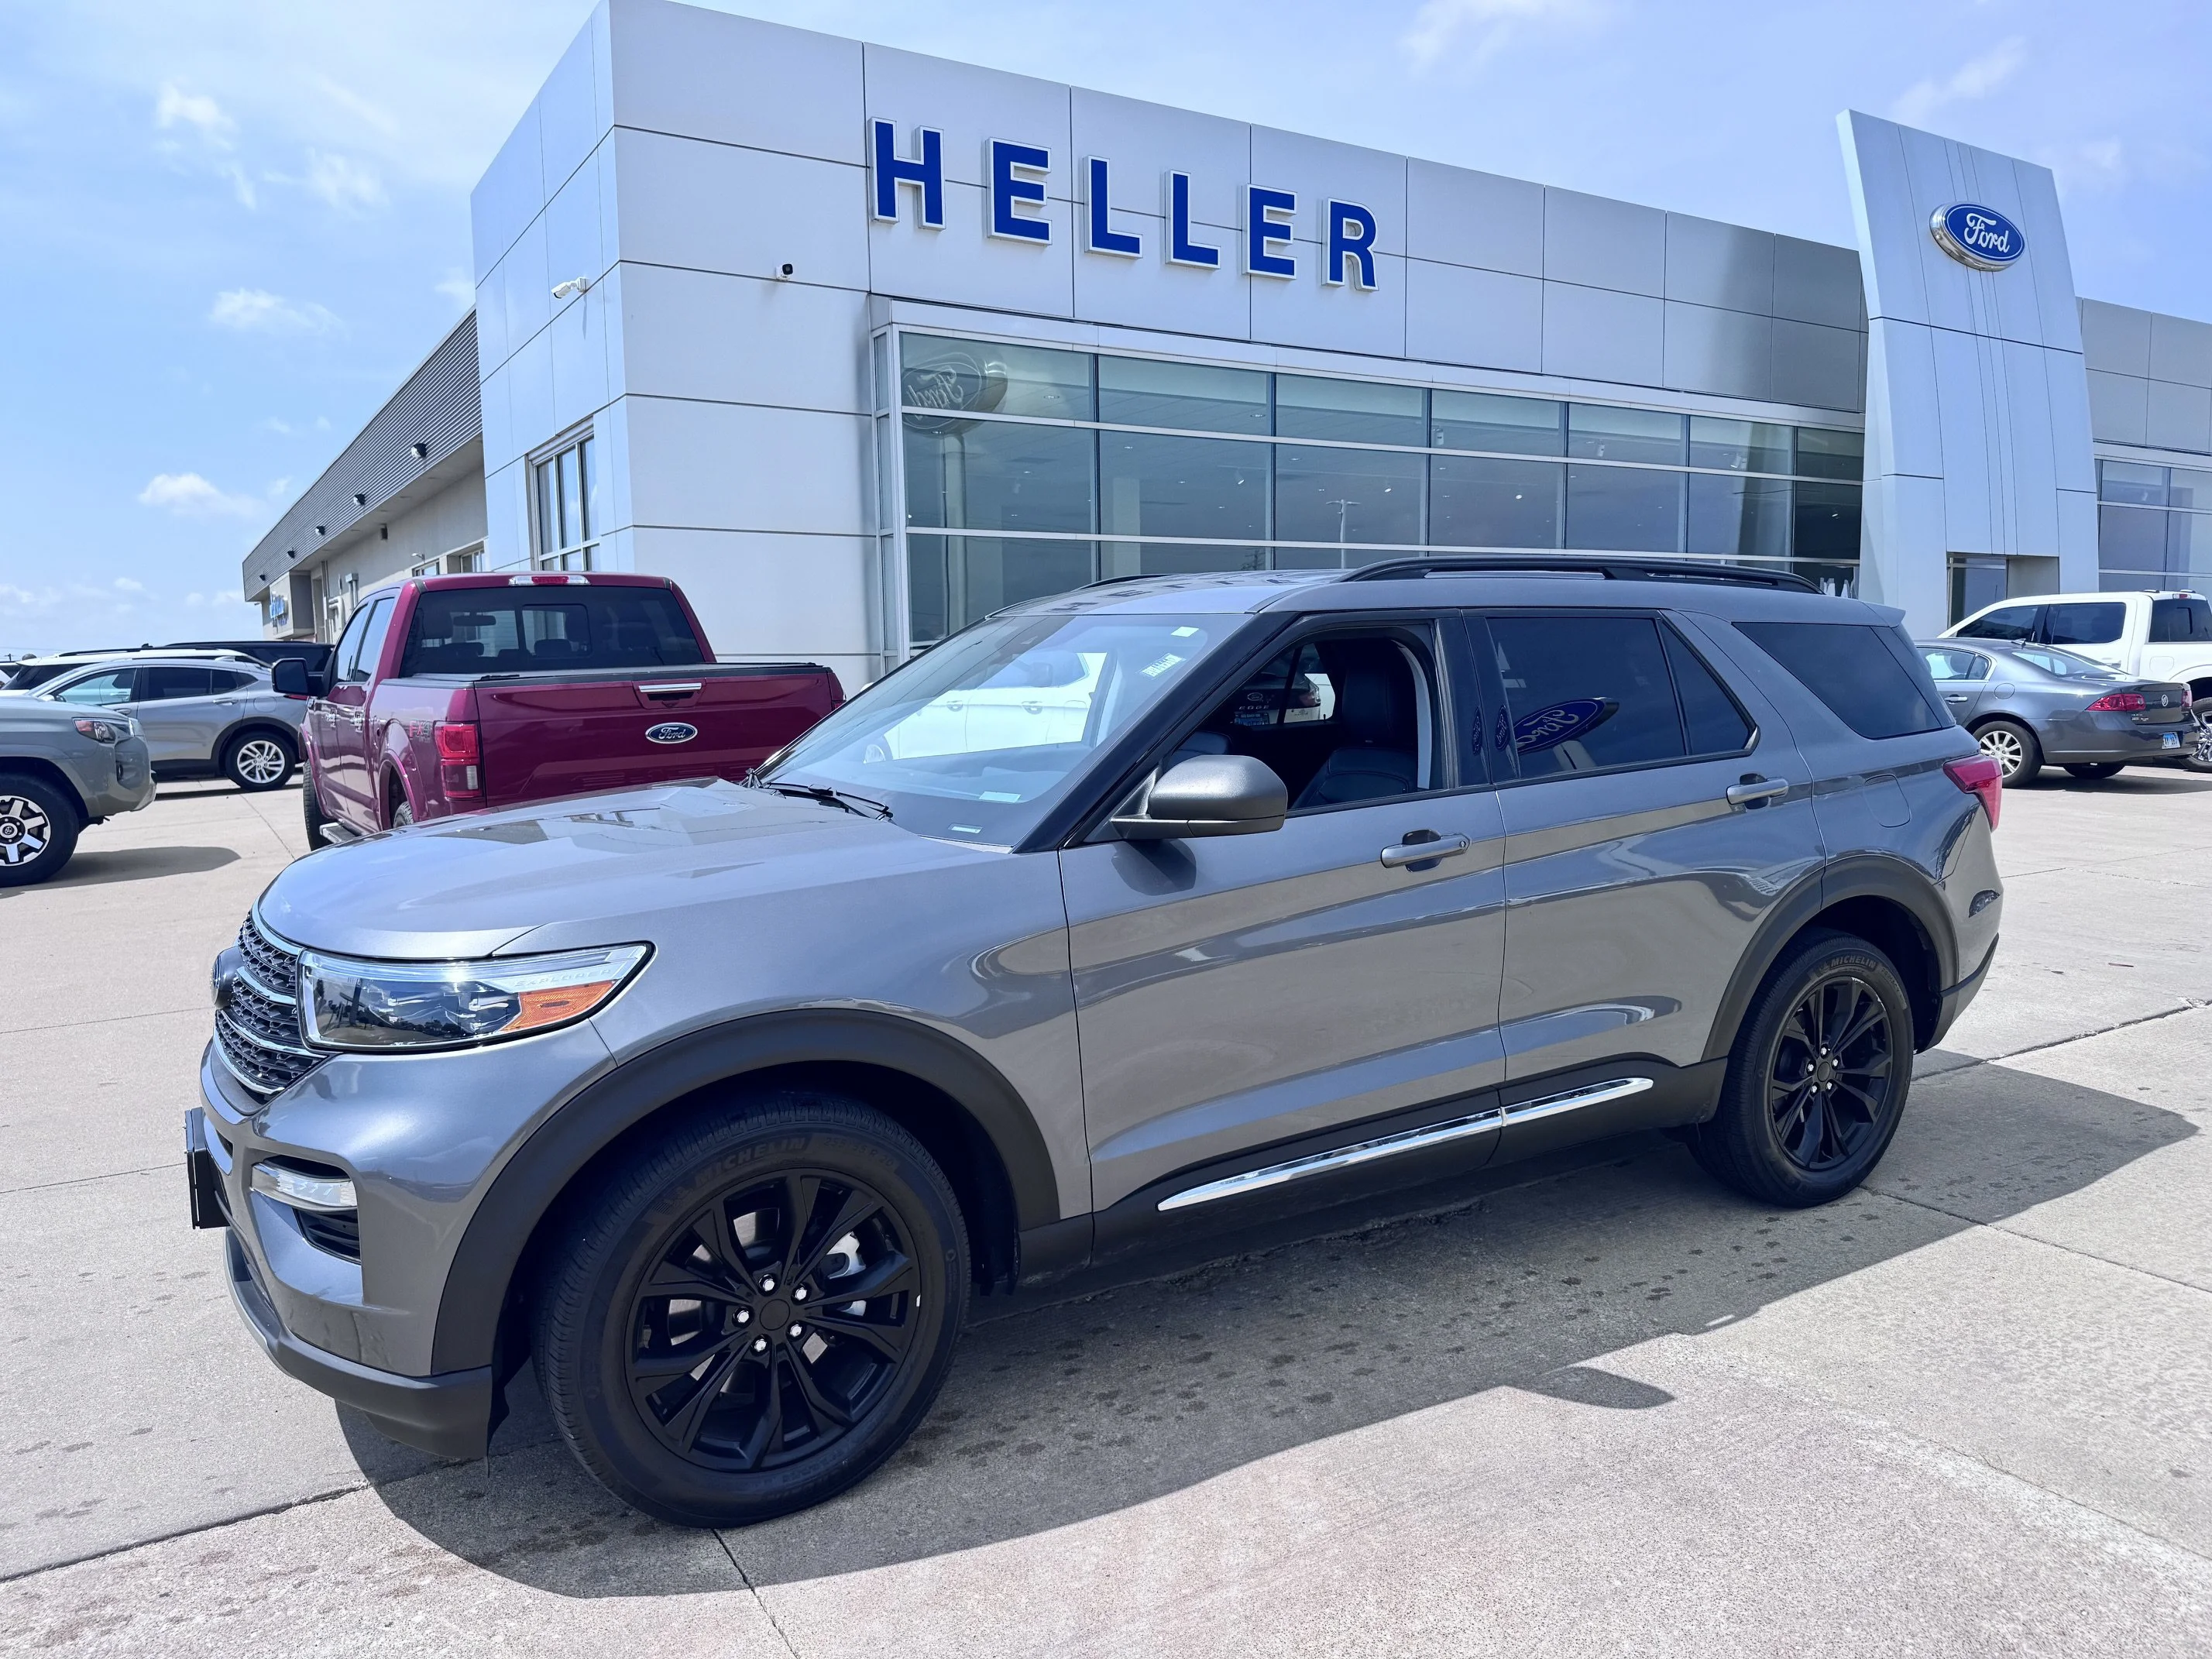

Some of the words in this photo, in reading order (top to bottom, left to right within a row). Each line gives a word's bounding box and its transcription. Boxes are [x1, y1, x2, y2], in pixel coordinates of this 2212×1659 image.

[869, 117, 1379, 291] HELLER
[1964, 213, 2010, 253] Ford
[409, 720, 431, 737] FX4
[658, 726, 686, 740] Ford
[1831, 955, 1877, 968] MICHELIN
[514, 968, 611, 988] EXPLORER
[695, 1137, 806, 1188] MICHELIN
